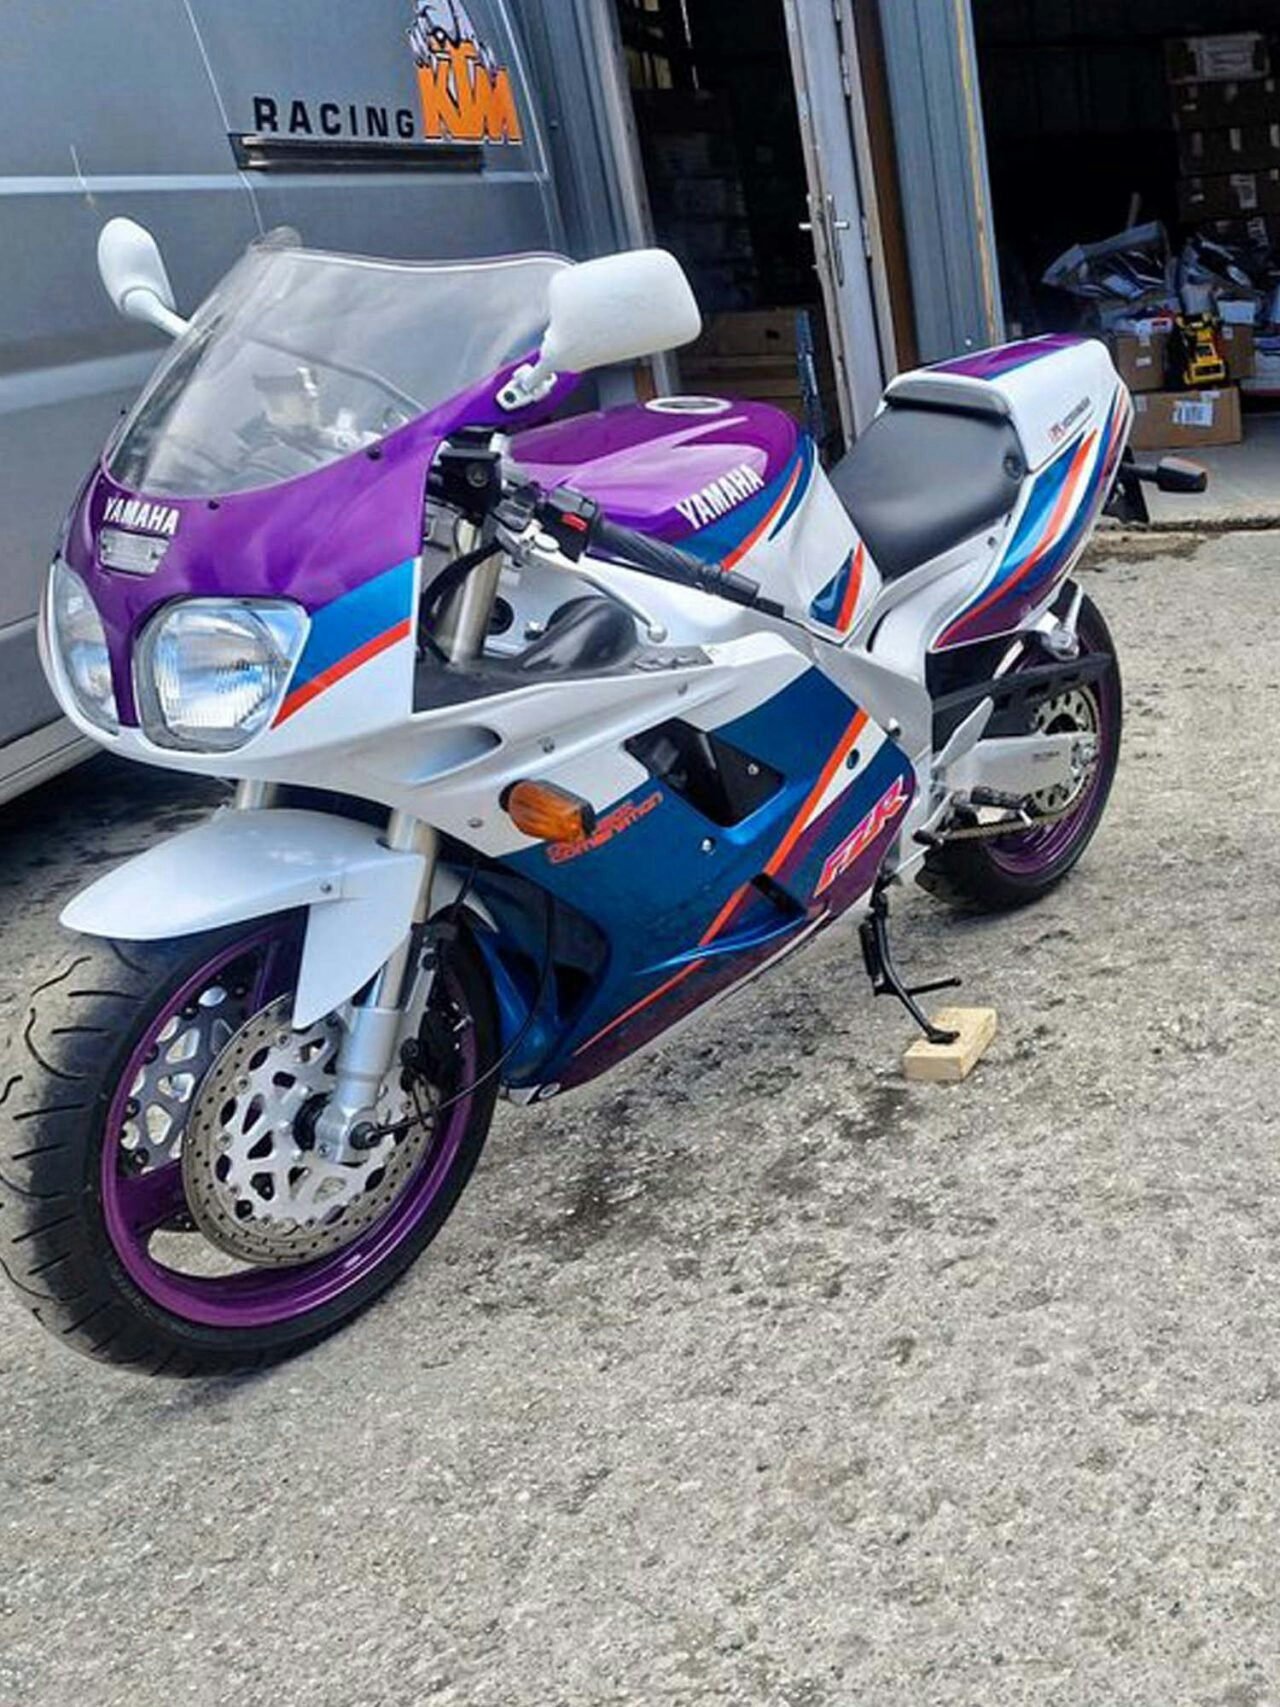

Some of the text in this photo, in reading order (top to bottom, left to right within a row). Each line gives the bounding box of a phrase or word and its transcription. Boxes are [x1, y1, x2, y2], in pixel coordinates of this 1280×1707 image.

[253, 40, 523, 145] RACING KTM
[103, 497, 179, 535] YAMAHA
[674, 464, 765, 530] YAMAHA
[813, 775, 909, 899] FZR
